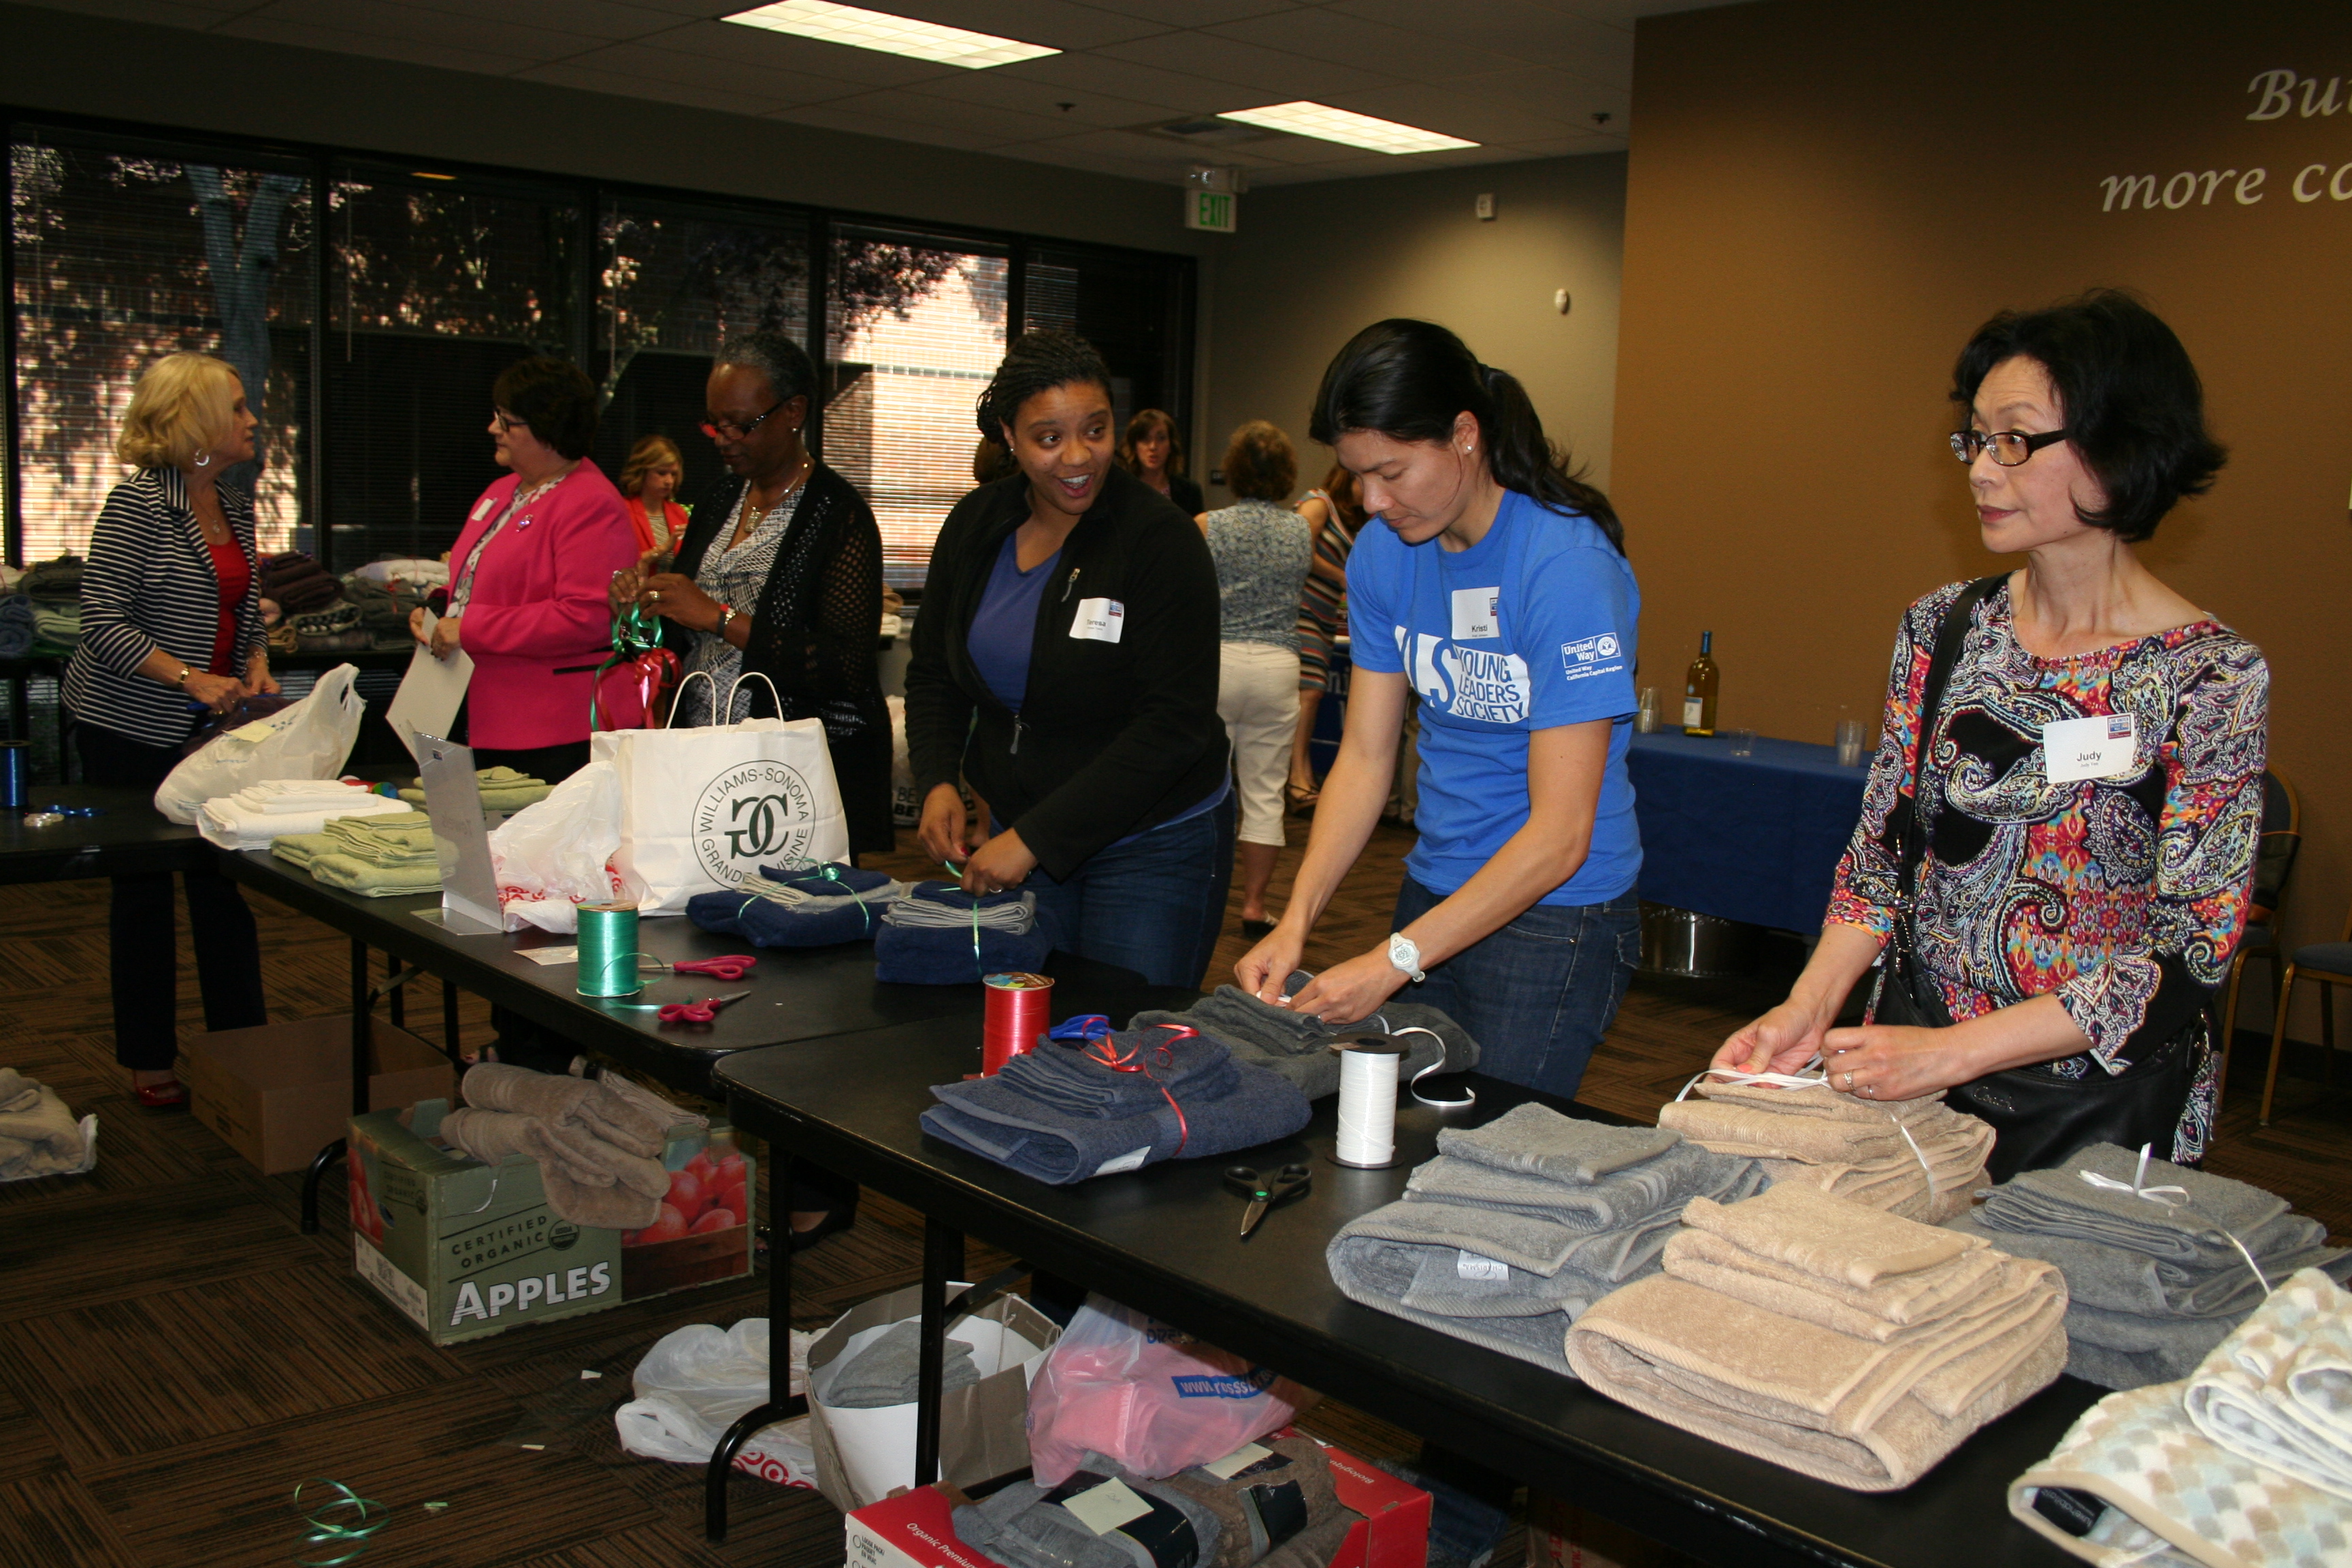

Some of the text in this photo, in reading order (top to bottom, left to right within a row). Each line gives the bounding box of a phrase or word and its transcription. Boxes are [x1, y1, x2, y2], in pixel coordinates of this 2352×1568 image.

[2100, 167, 2266, 212] more
[1199, 193, 1230, 227] EXIT
[1087, 619, 1106, 627] Teresa
[1471, 624, 1488, 632] Kristi
[1563, 640, 1594, 655] United
[1576, 651, 1595, 661] Way
[1455, 648, 1512, 683] YOUNG
[1459, 674, 1521, 704] LEADERS
[1456, 696, 1524, 723] SOCIETY
[2076, 751, 2102, 762] Judy
[699, 767, 810, 833] WILLIAMS-SONOMA
[702, 838, 746, 883] GRAND
[451, 1215, 547, 1256] CERTIFIED
[461, 1231, 544, 1269] ORGANIC
[450, 1260, 611, 1326] APPLES
[906, 1522, 941, 1547] Organic
